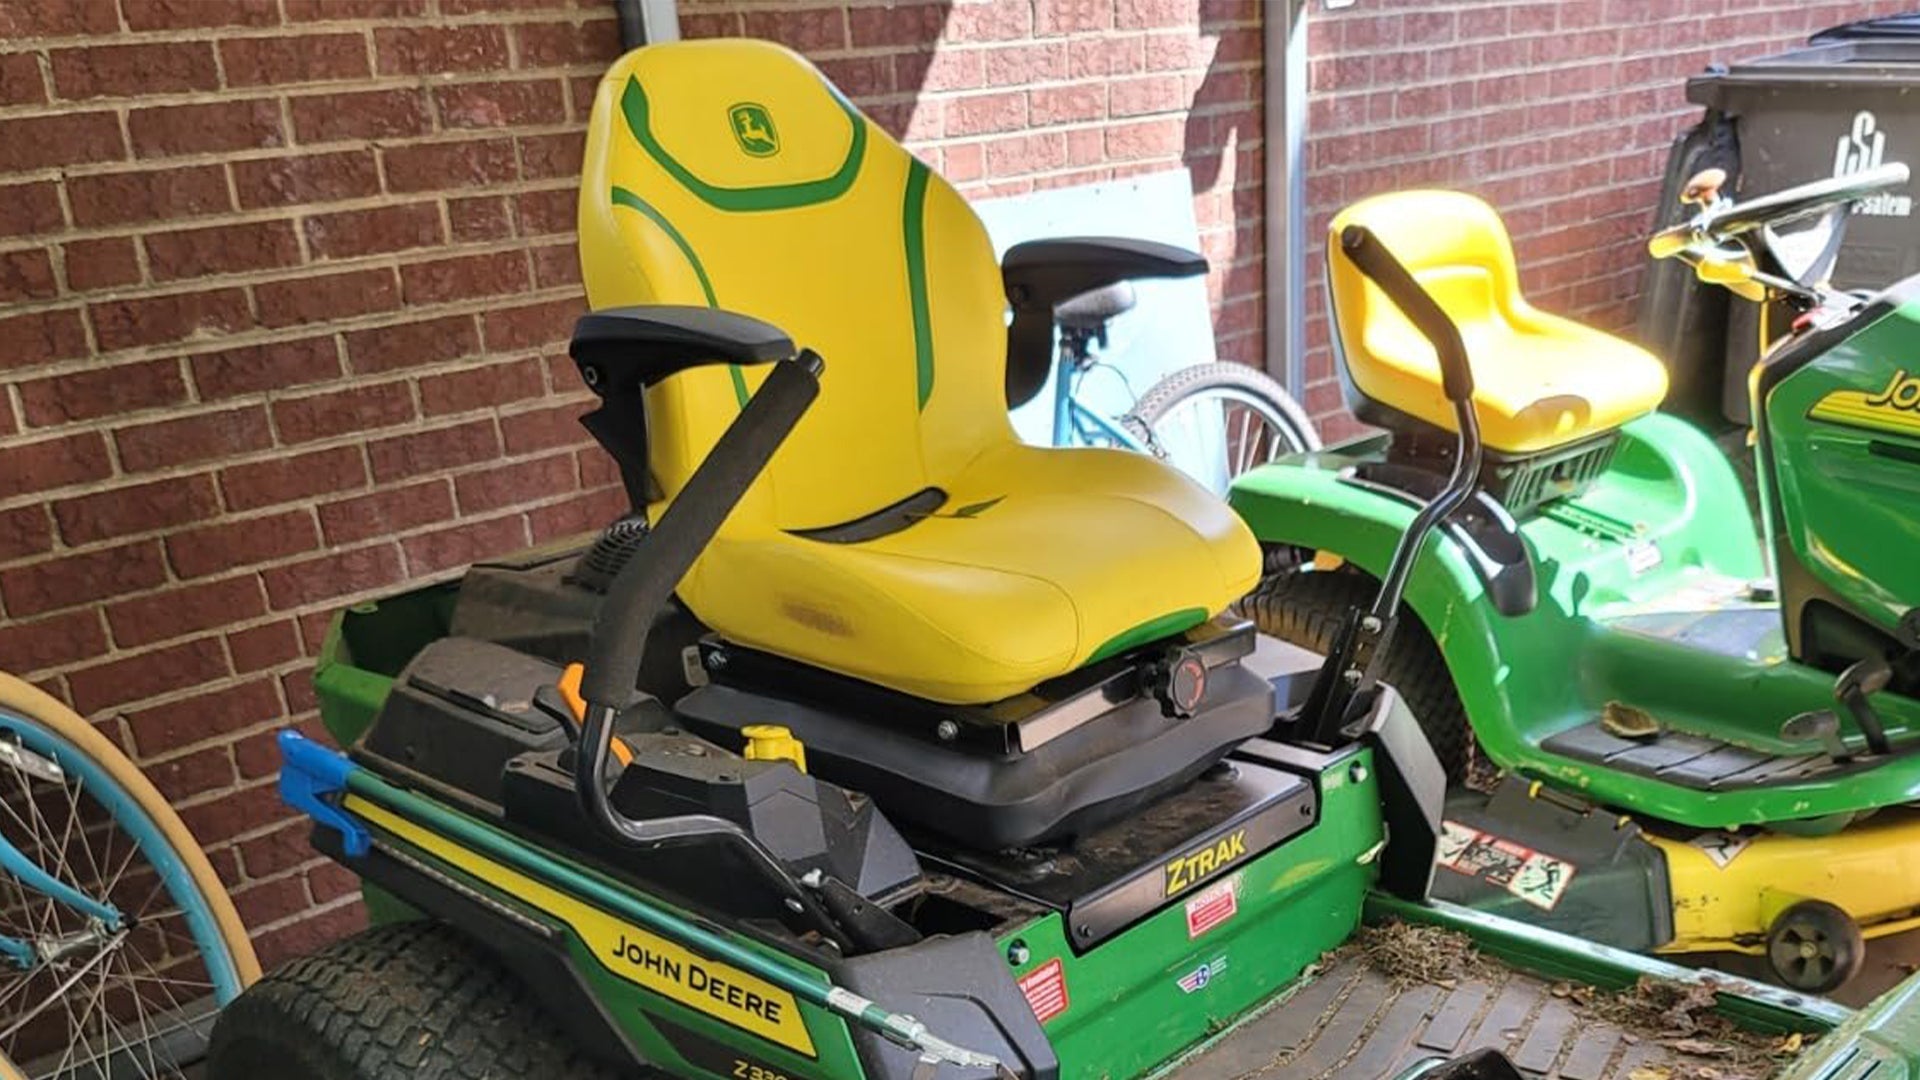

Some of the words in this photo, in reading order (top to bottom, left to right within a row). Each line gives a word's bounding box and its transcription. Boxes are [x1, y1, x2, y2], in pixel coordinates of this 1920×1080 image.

[1865, 368, 1920, 413] JO
[1166, 829, 1246, 896] ZTRAK
[612, 935, 682, 983] JOHN
[688, 964, 783, 1025] DEERE
